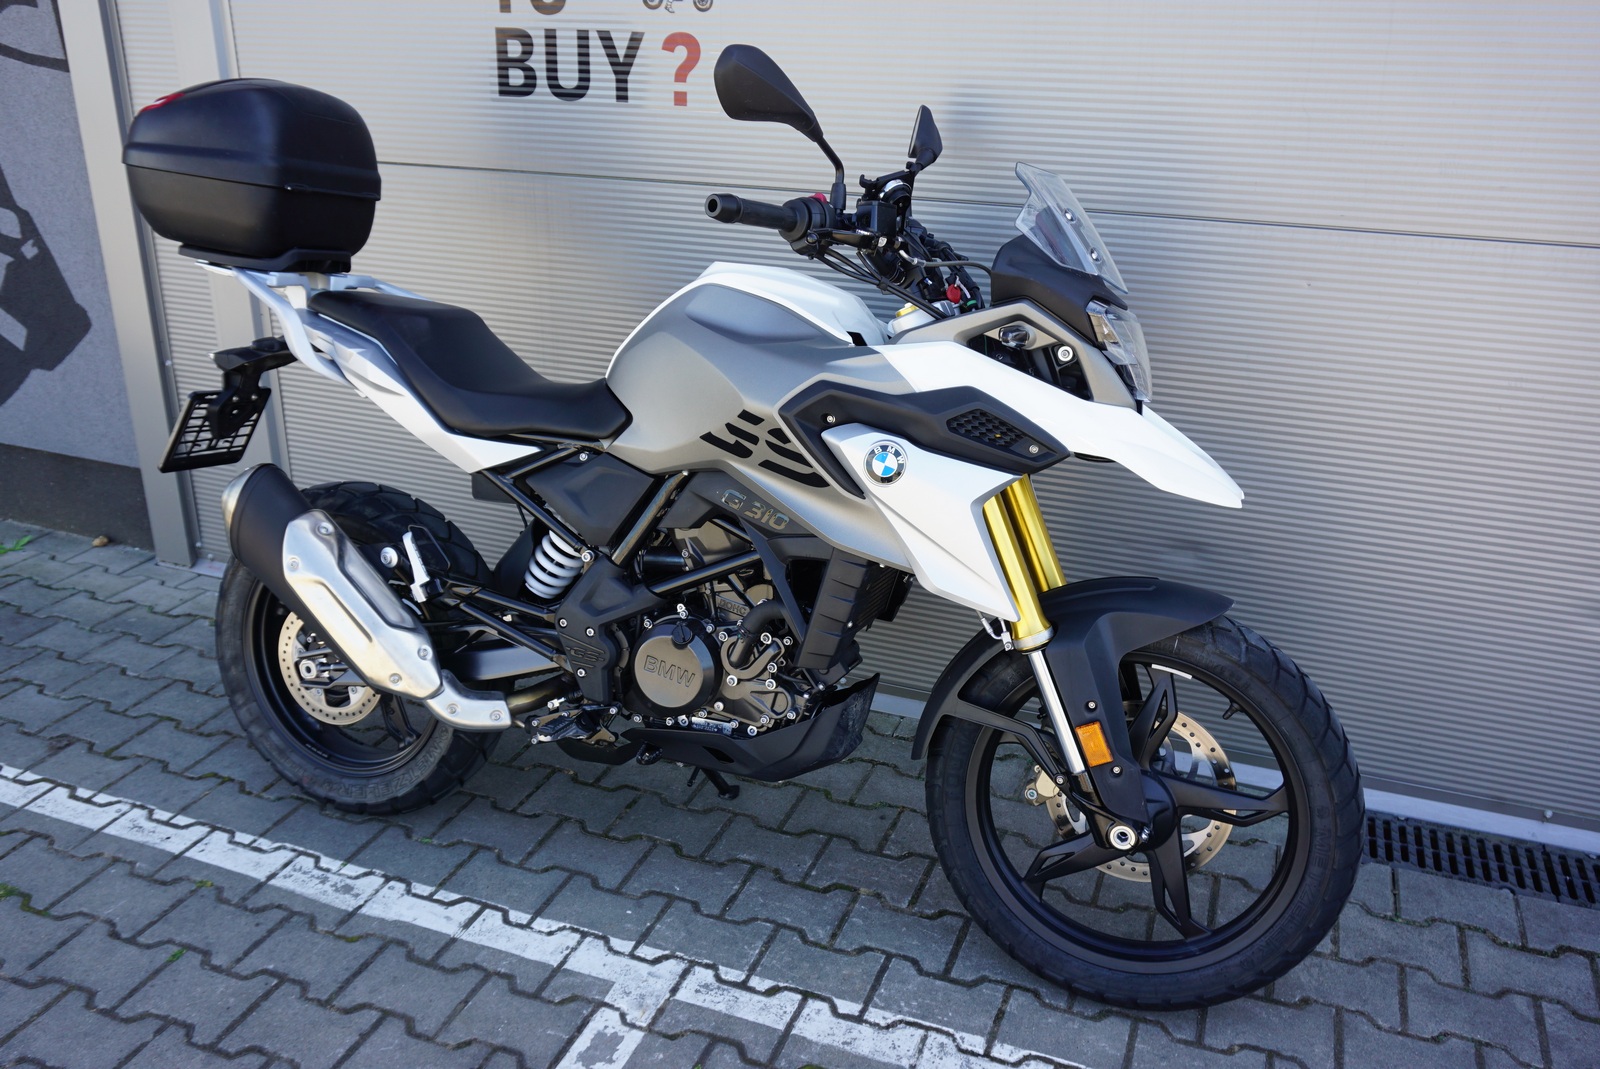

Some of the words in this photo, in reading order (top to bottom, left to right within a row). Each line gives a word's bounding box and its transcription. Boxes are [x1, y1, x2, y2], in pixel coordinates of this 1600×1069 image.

[495, 26, 645, 102] BUY
[662, 31, 702, 107] ?
[874, 445, 904, 464] BMW
[721, 489, 747, 511] G
[744, 501, 790, 530] 310
[643, 654, 696, 688] BMW
